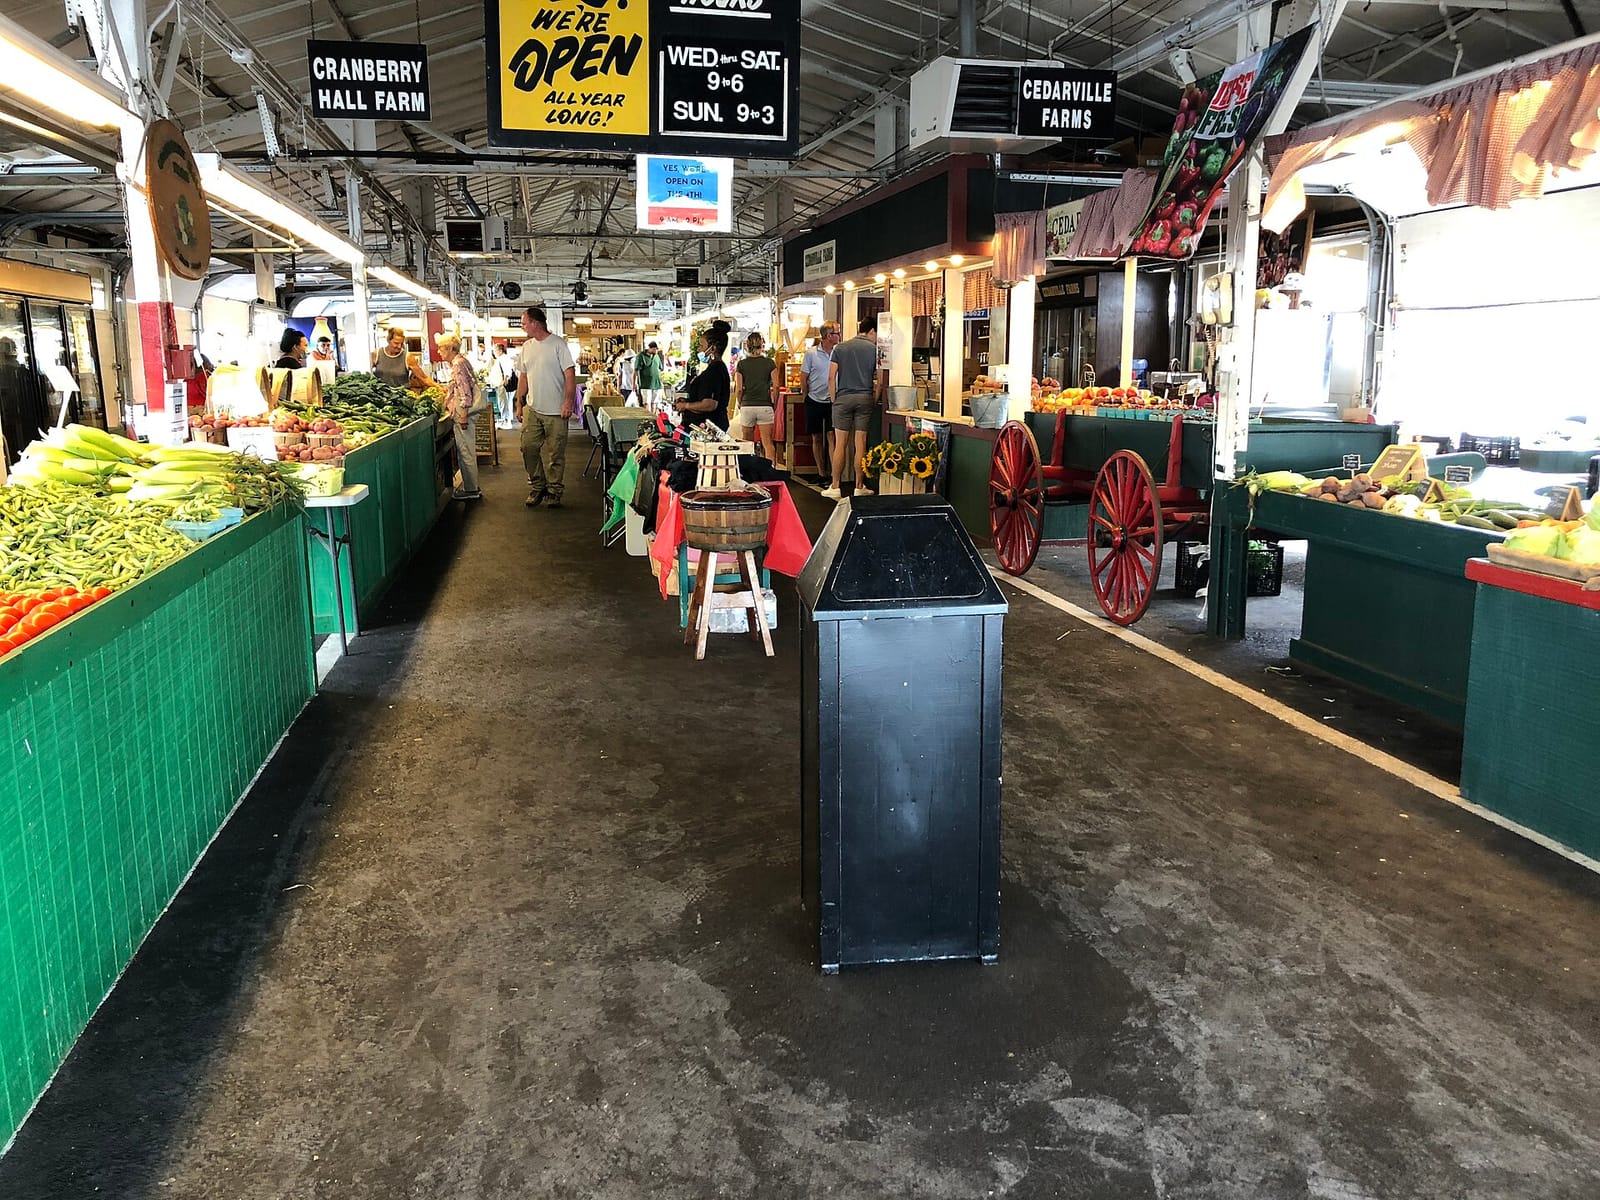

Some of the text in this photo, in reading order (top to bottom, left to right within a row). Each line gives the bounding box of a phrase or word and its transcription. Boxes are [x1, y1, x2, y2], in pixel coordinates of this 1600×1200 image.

[530, 5, 611, 33] WE'RE
[313, 56, 422, 83] CRANBERRY
[508, 33, 643, 92] OPEN
[667, 45, 781, 71] WED. thru SAT.
[707, 71, 720, 91] 9
[731, 74, 744, 93] 6
[1023, 79, 1112, 102] CEDARVILLE
[318, 89, 426, 112] HALL FARM
[544, 90, 626, 107] ALL YEAR
[545, 109, 613, 127] LONG!
[673, 100, 775, 125] SUN. 9 to 3
[1041, 107, 1092, 130] FARMS
[663, 164, 679, 173] YES,
[665, 177, 704, 186] OPEN ON
[614, 320, 635, 330] WING
